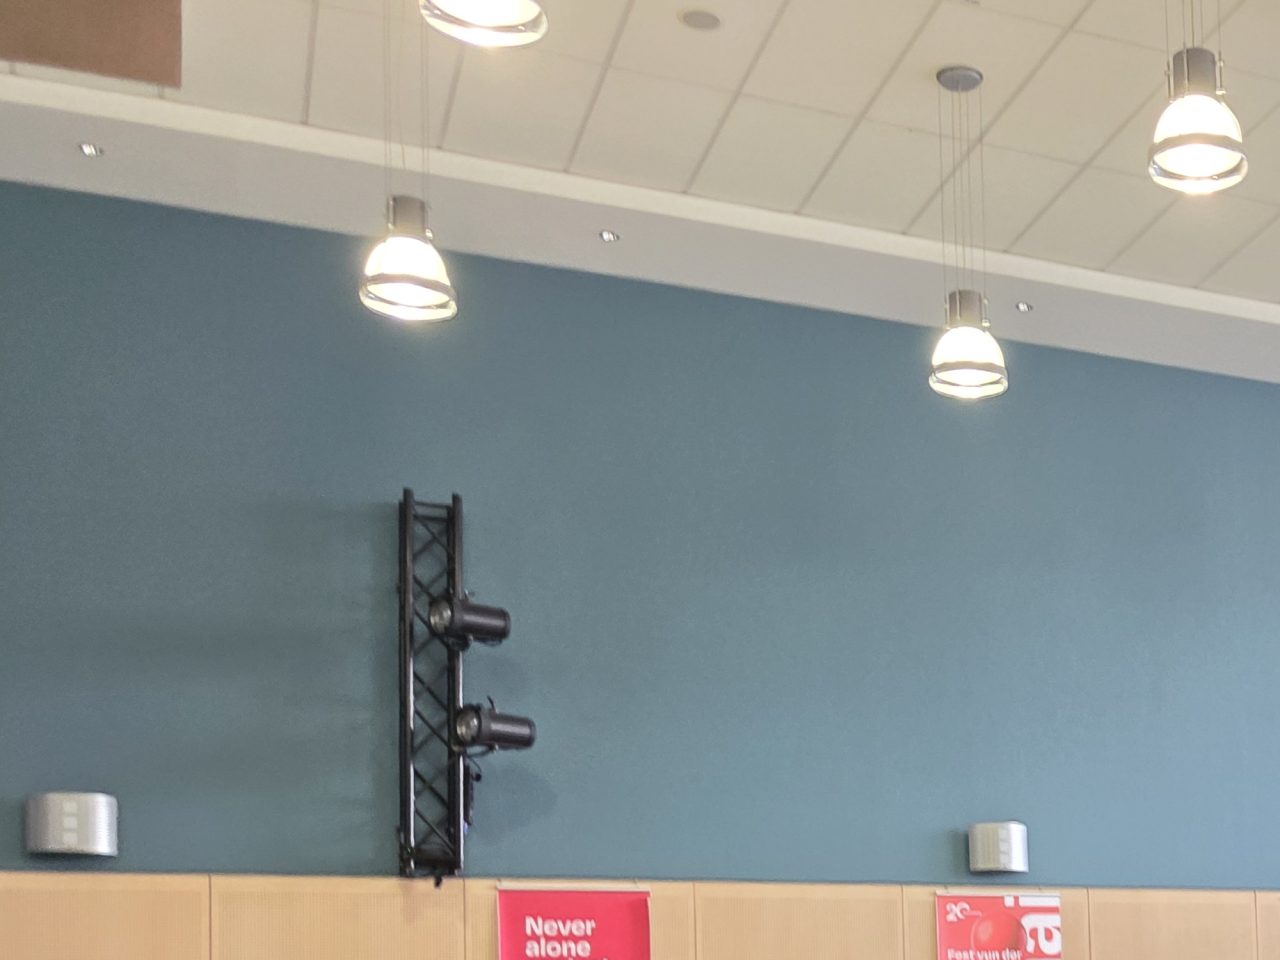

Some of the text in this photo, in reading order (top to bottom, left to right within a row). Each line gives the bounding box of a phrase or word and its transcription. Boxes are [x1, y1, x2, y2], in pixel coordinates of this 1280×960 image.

[525, 916, 595, 936] Never
[525, 938, 591, 957] alone
[947, 948, 1022, 960] Fest vun der
